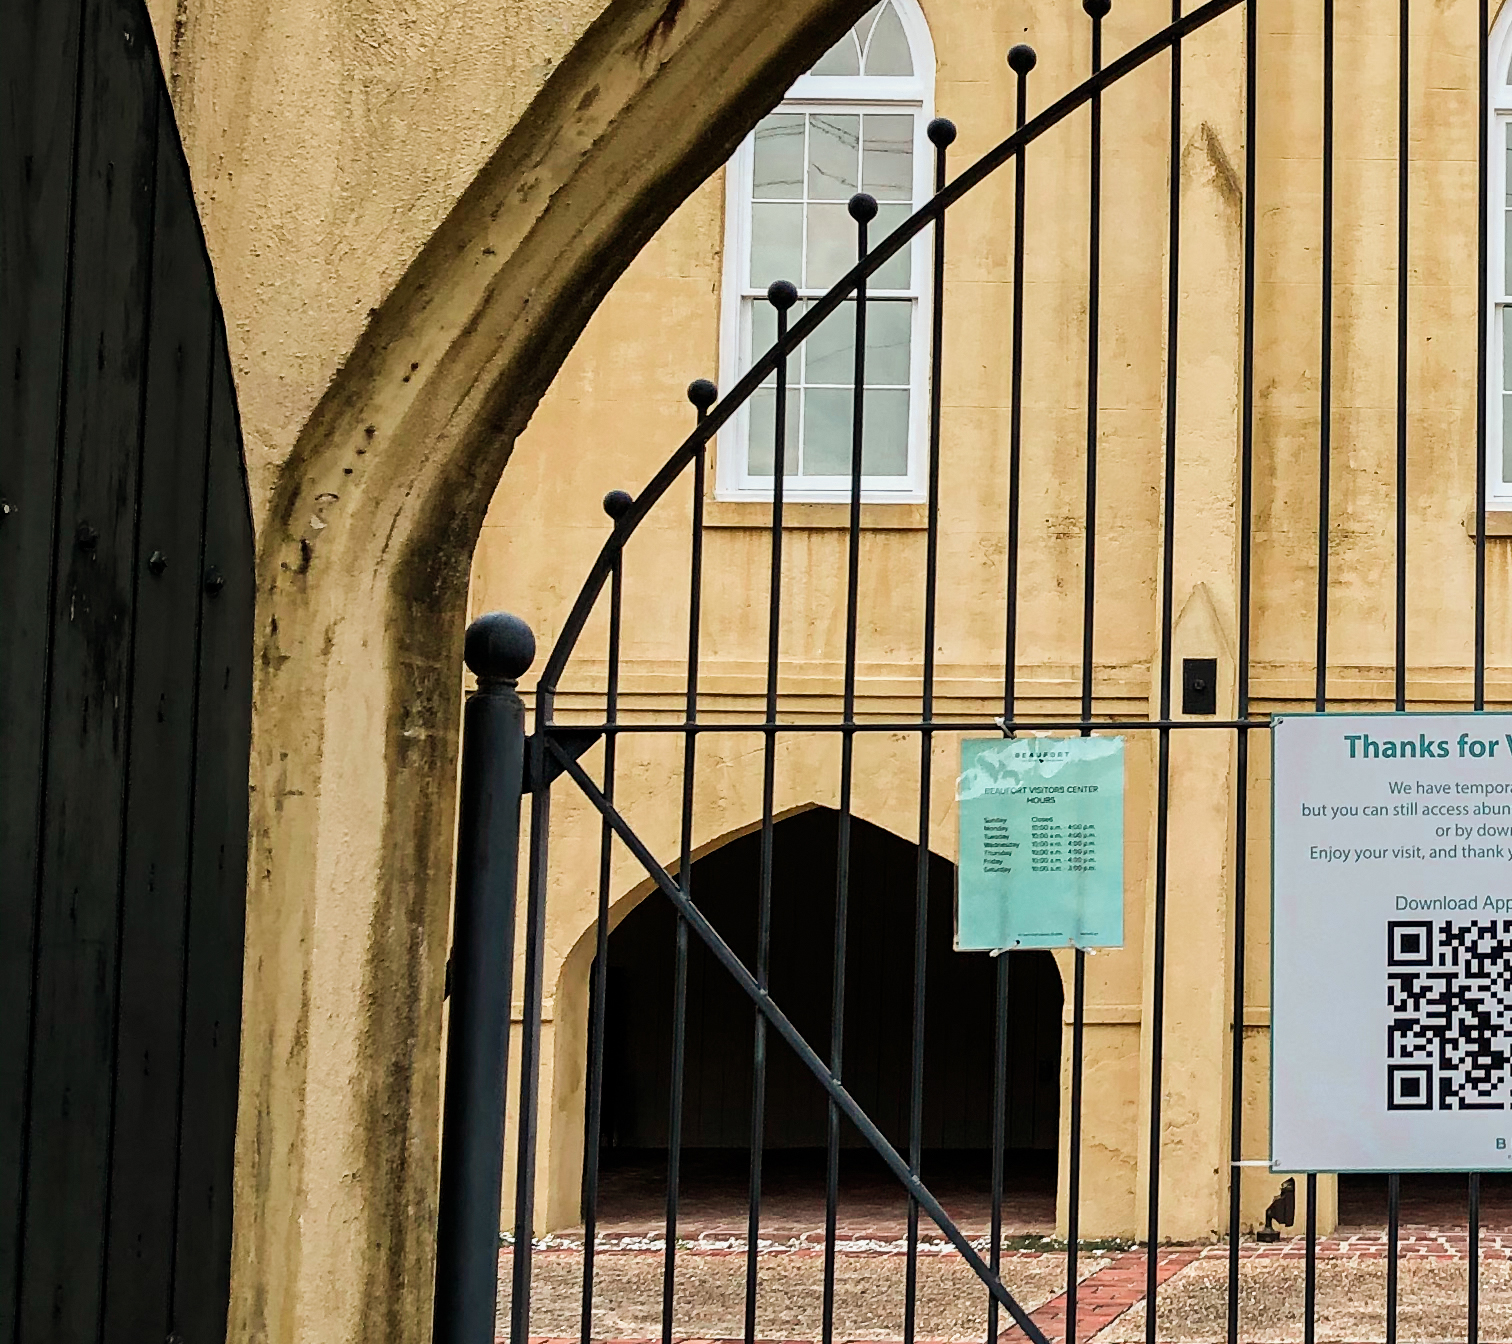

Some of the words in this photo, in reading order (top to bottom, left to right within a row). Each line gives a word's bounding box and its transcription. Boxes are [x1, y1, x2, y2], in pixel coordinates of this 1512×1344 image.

[1344, 733, 1450, 758] Thanks
[1457, 733, 1499, 758] for
[1029, 786, 1064, 794] VISITORS
[1388, 781, 1412, 794] We
[1416, 781, 1451, 794] have
[1302, 803, 1327, 816] but
[1331, 806, 1359, 820] you
[1363, 806, 1389, 816] can
[1393, 802, 1418, 816] still
[1422, 805, 1469, 816] access
[1435, 826, 1451, 837] or
[1455, 824, 1472, 840] by
[1310, 846, 1350, 862] Enjoy
[1355, 849, 1388, 862] your
[1392, 845, 1425, 860] visit,
[1429, 845, 1457, 858] and
[1462, 845, 1504, 858] thank
[1395, 896, 1478, 911] Download
